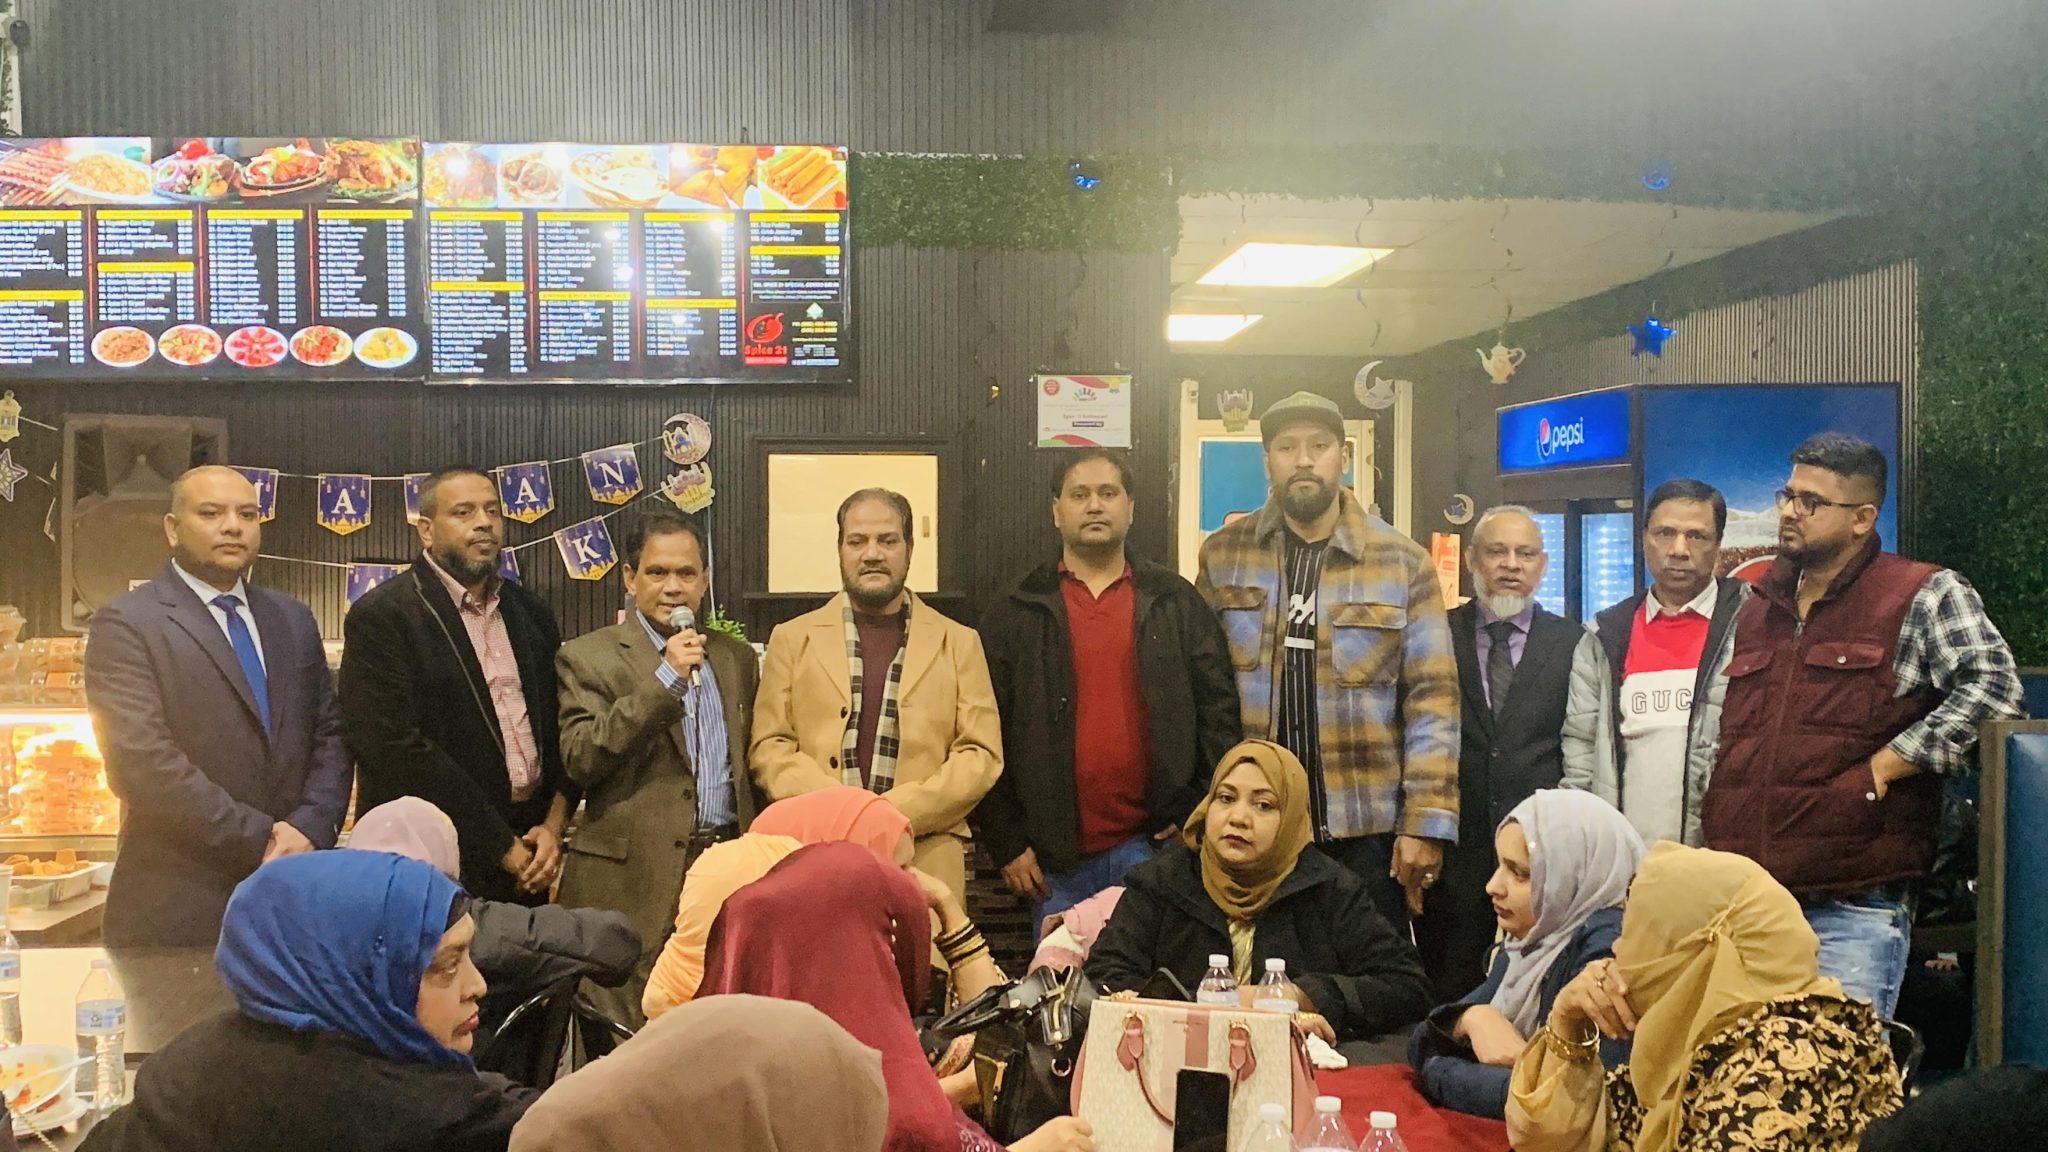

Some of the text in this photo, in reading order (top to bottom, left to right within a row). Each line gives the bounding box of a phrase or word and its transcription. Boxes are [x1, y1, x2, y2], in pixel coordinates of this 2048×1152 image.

[745, 343, 774, 356] Spice
[775, 345, 788, 355] 21
[1552, 416, 1584, 454] pepsi
[571, 533, 602, 564] K
[1631, 688, 1692, 714] GUC
